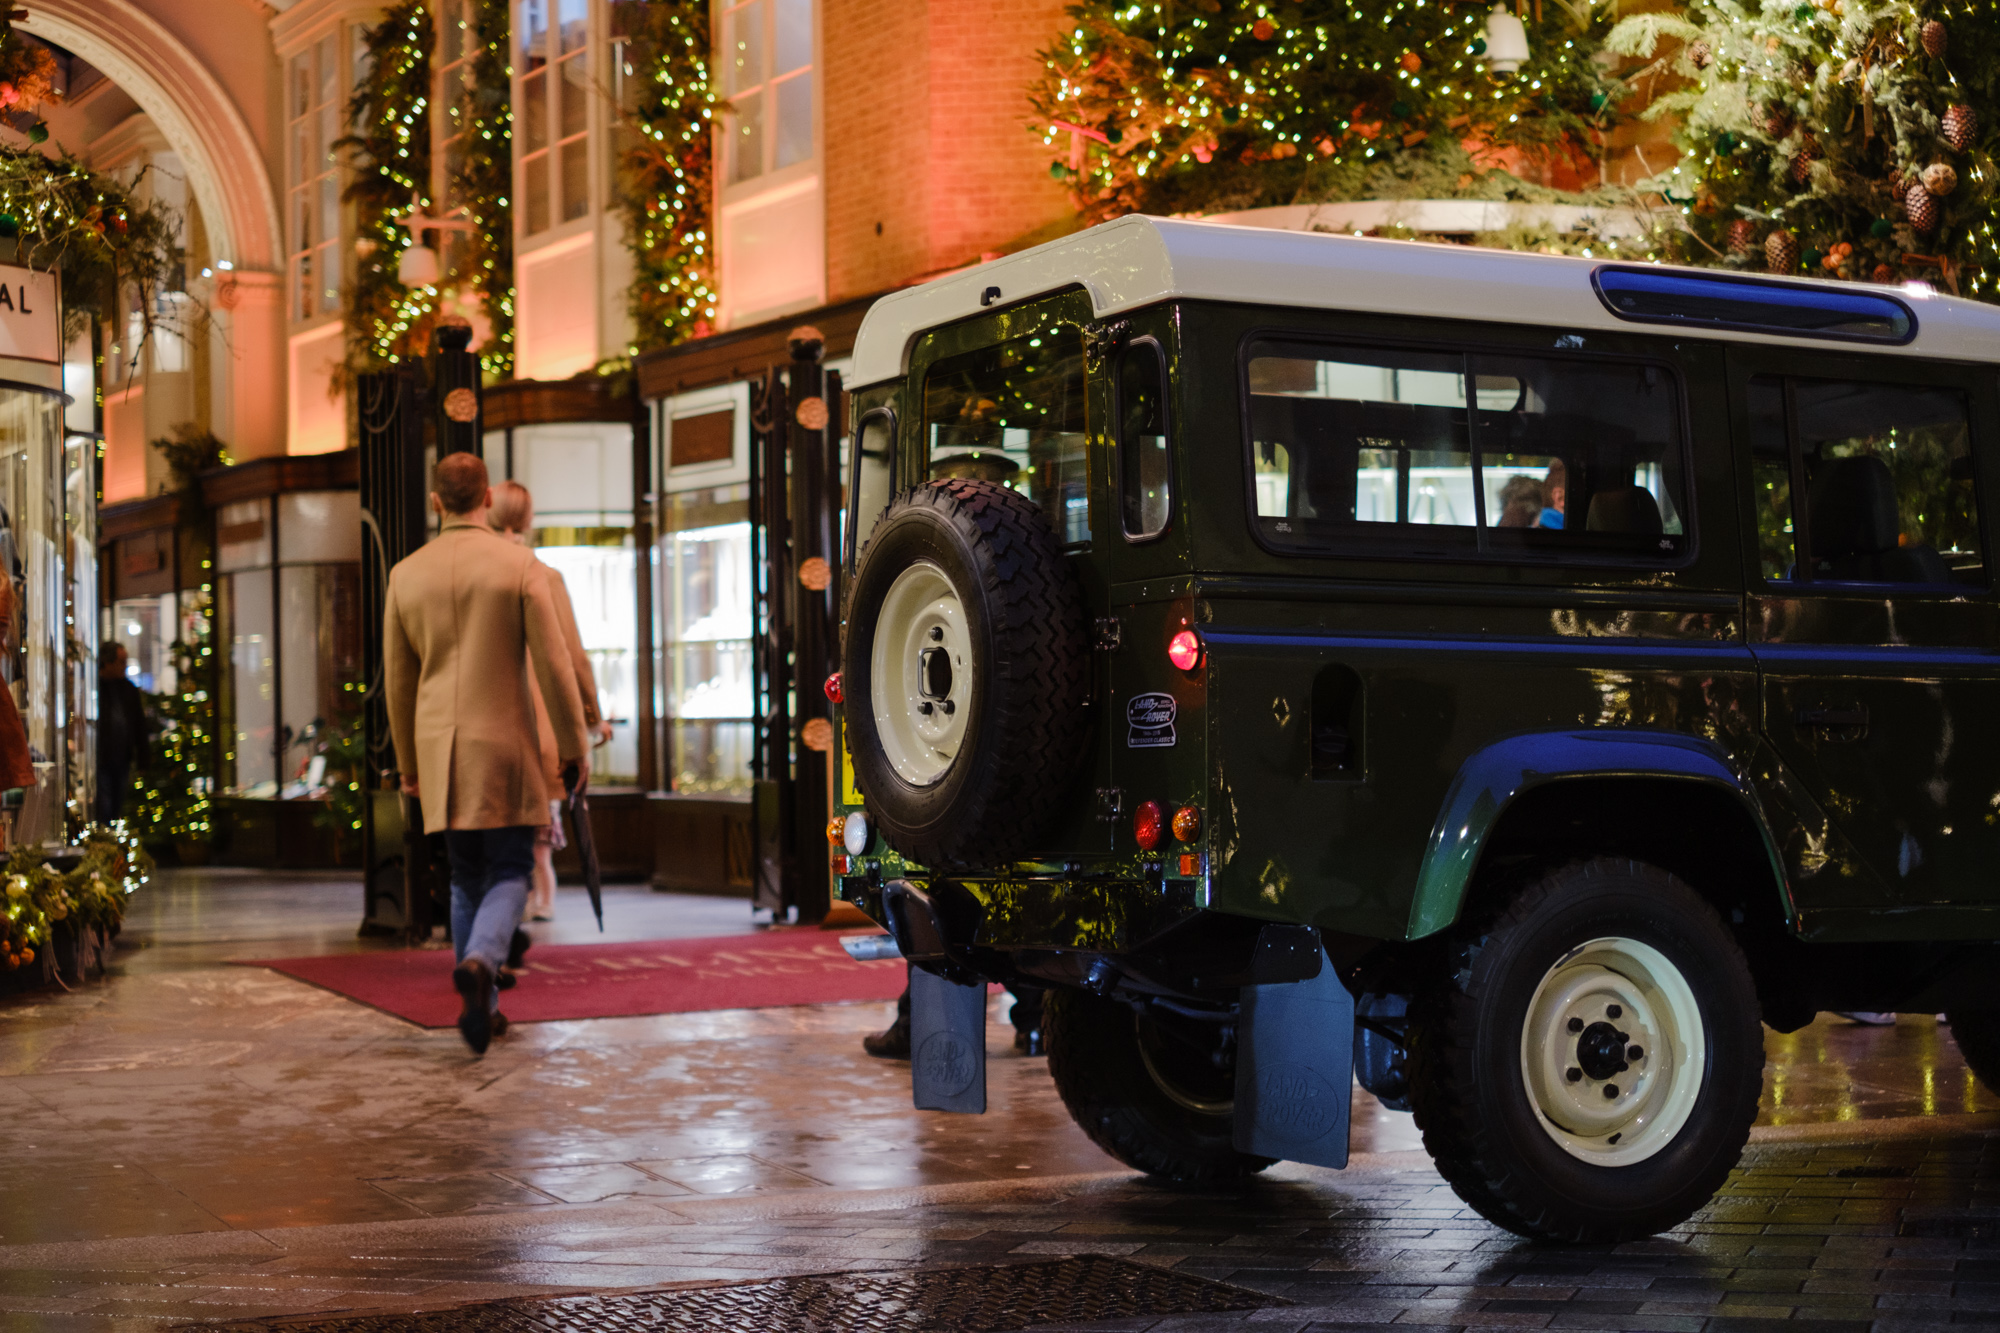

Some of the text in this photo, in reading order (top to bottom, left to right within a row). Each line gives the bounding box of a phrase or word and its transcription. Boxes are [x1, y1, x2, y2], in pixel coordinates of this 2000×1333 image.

[1134, 698, 1155, 710] LAND
[1145, 711, 1171, 723] ROVER
[1153, 736, 1171, 744] CLASSIC
[1265, 1071, 1308, 1100] LAND
[1265, 1101, 1325, 1131] ROVER
